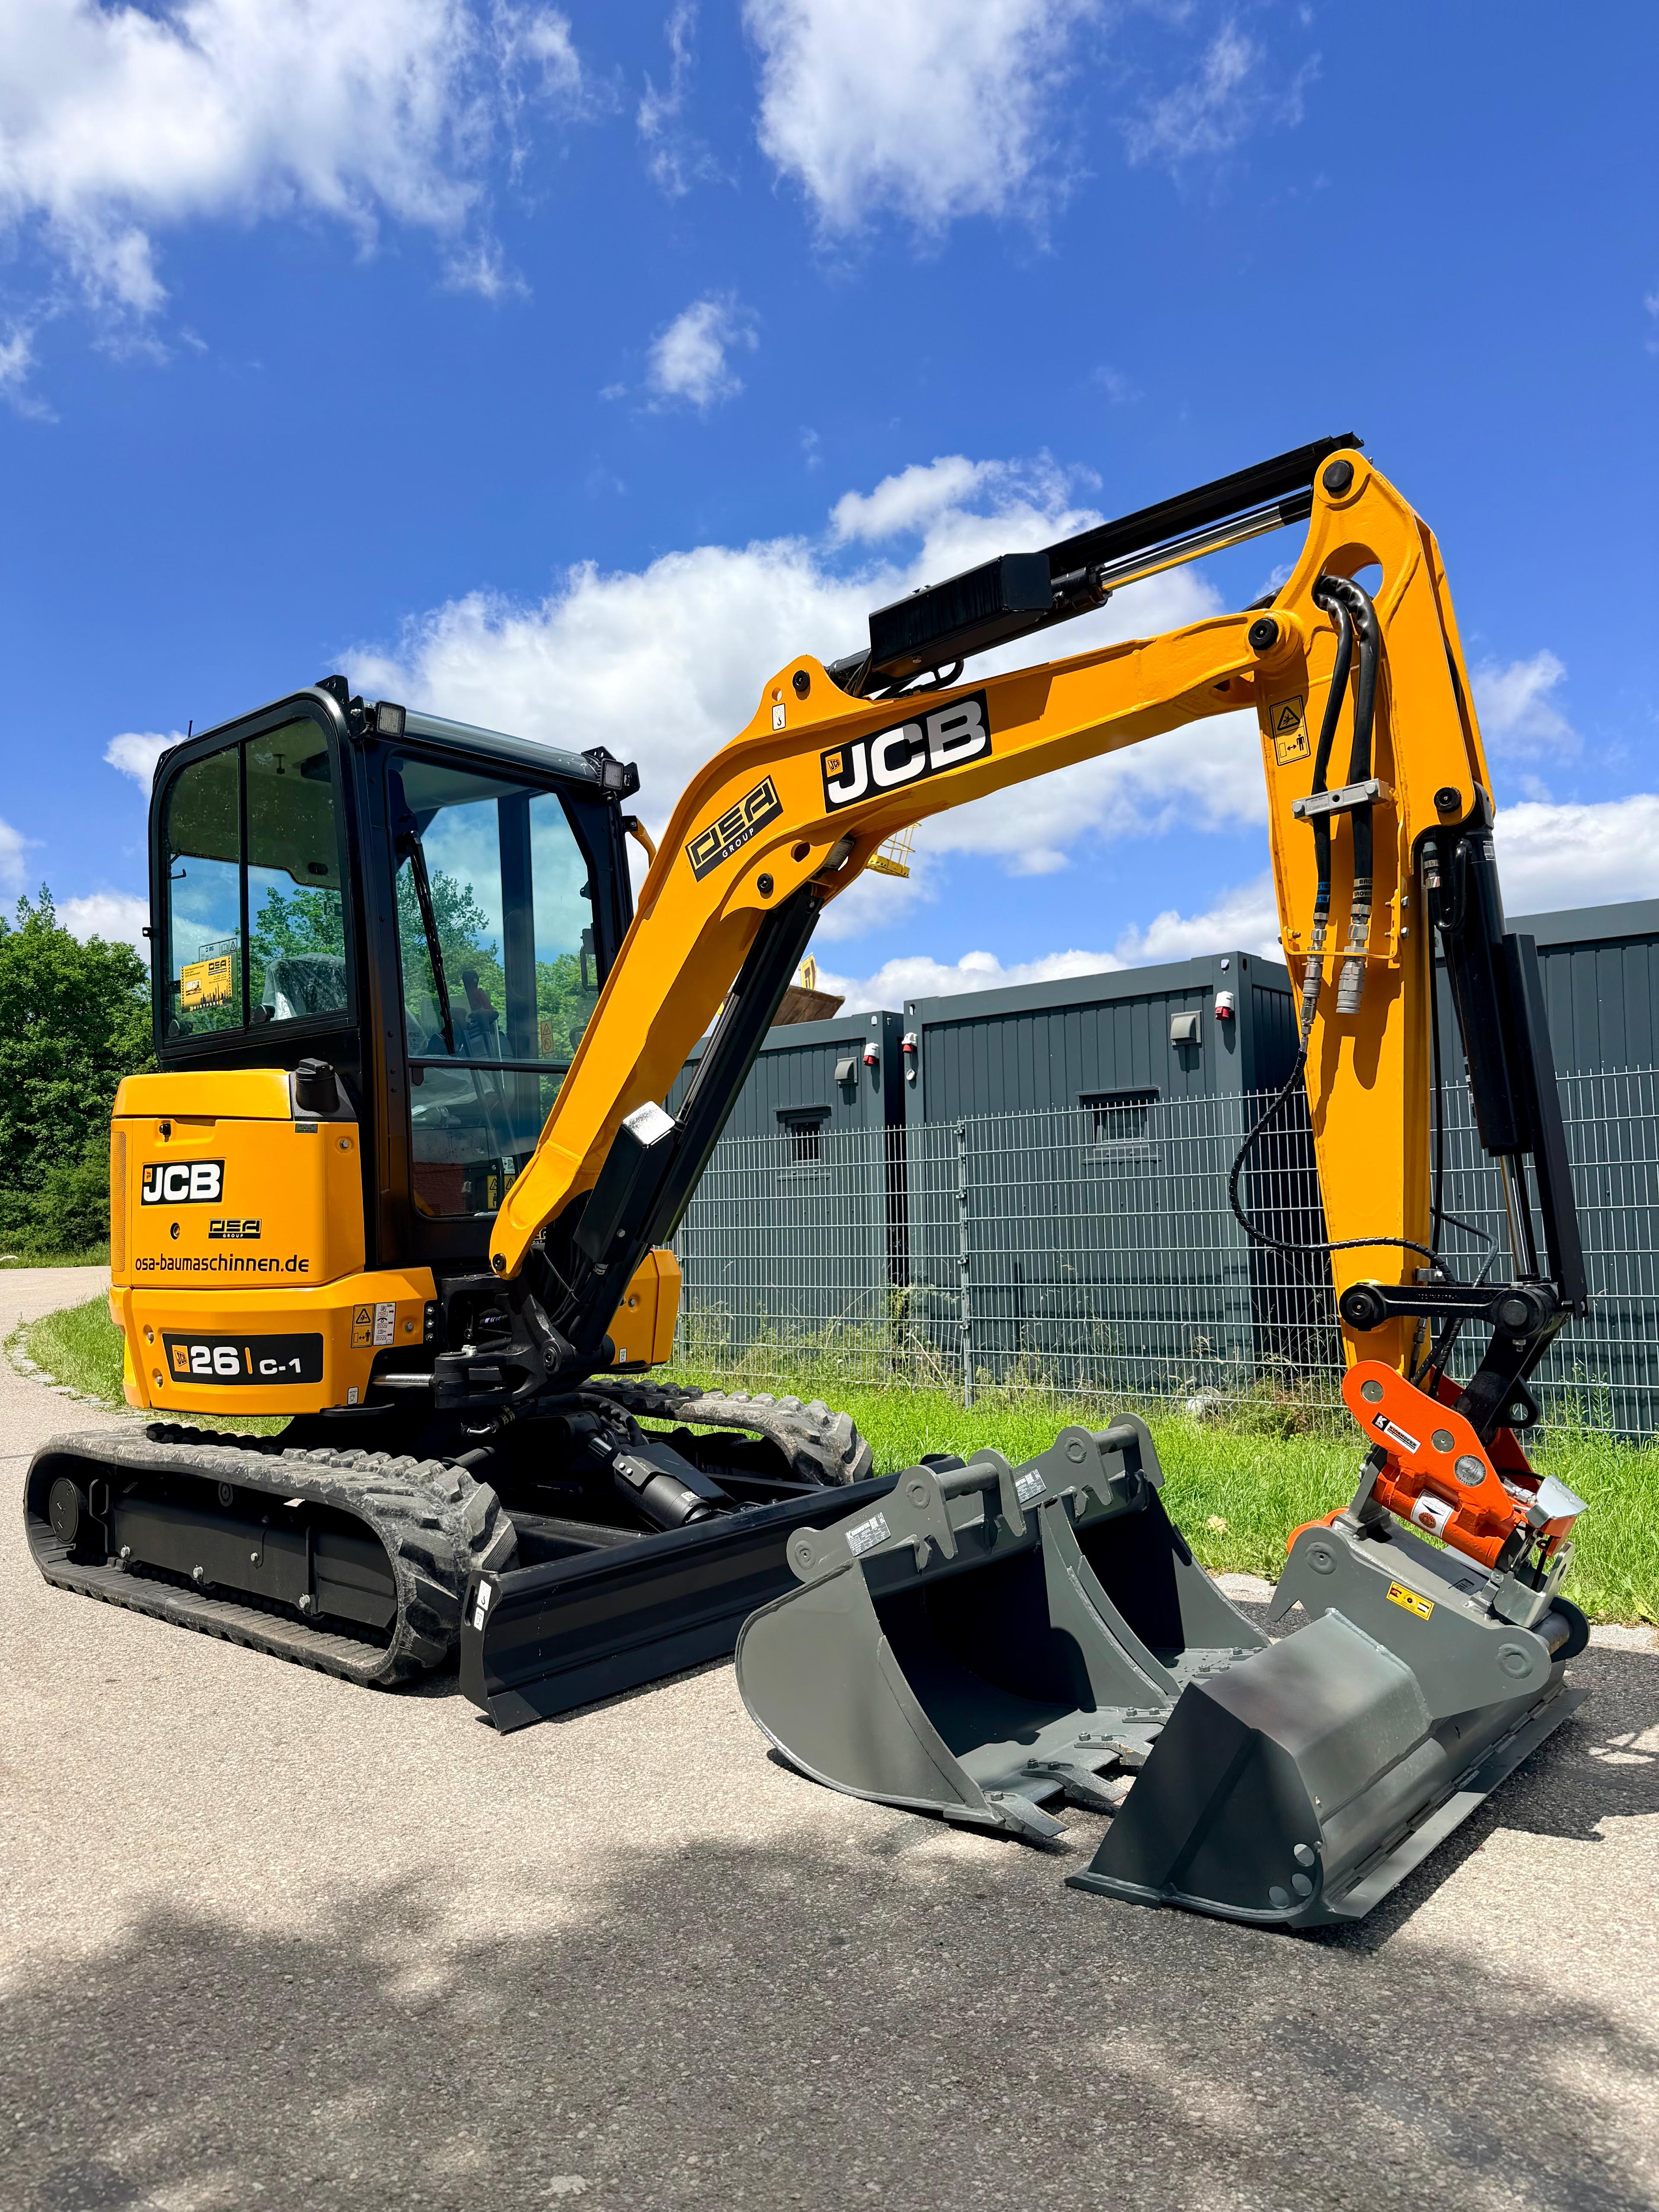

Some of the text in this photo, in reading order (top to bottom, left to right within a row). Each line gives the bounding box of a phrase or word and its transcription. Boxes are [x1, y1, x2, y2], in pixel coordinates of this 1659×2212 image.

[828, 701, 986, 804] JCB
[690, 782, 775, 866] OSA
[722, 828, 754, 858] GROUP
[143, 1163, 220, 1202] JCB
[210, 1220, 260, 1232] OSA
[135, 1253, 309, 1272] osa-baumaschinnen.de
[177, 1351, 187, 1365] JCB
[191, 1346, 302, 1375] 26 C-1
